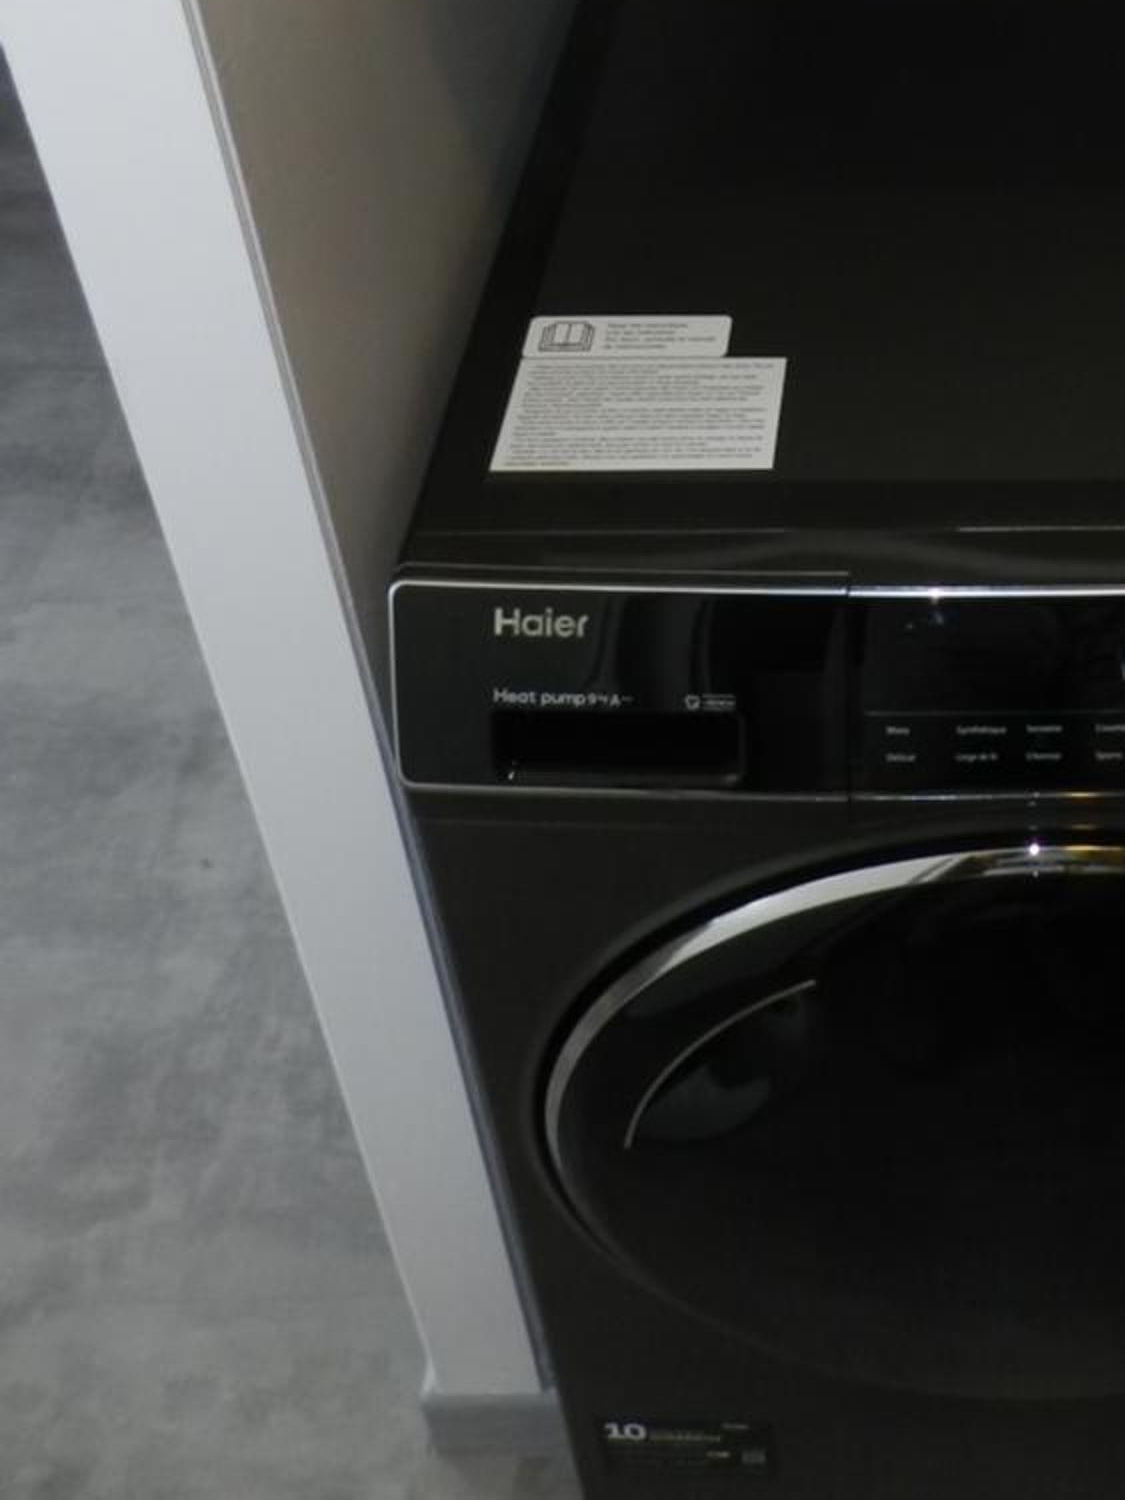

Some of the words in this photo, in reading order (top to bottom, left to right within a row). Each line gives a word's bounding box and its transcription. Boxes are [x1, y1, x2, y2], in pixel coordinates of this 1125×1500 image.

[494, 607, 589, 638] Haier
[493, 688, 537, 705] Heat
[540, 691, 586, 709] pump
[605, 1422, 648, 1441] 10
